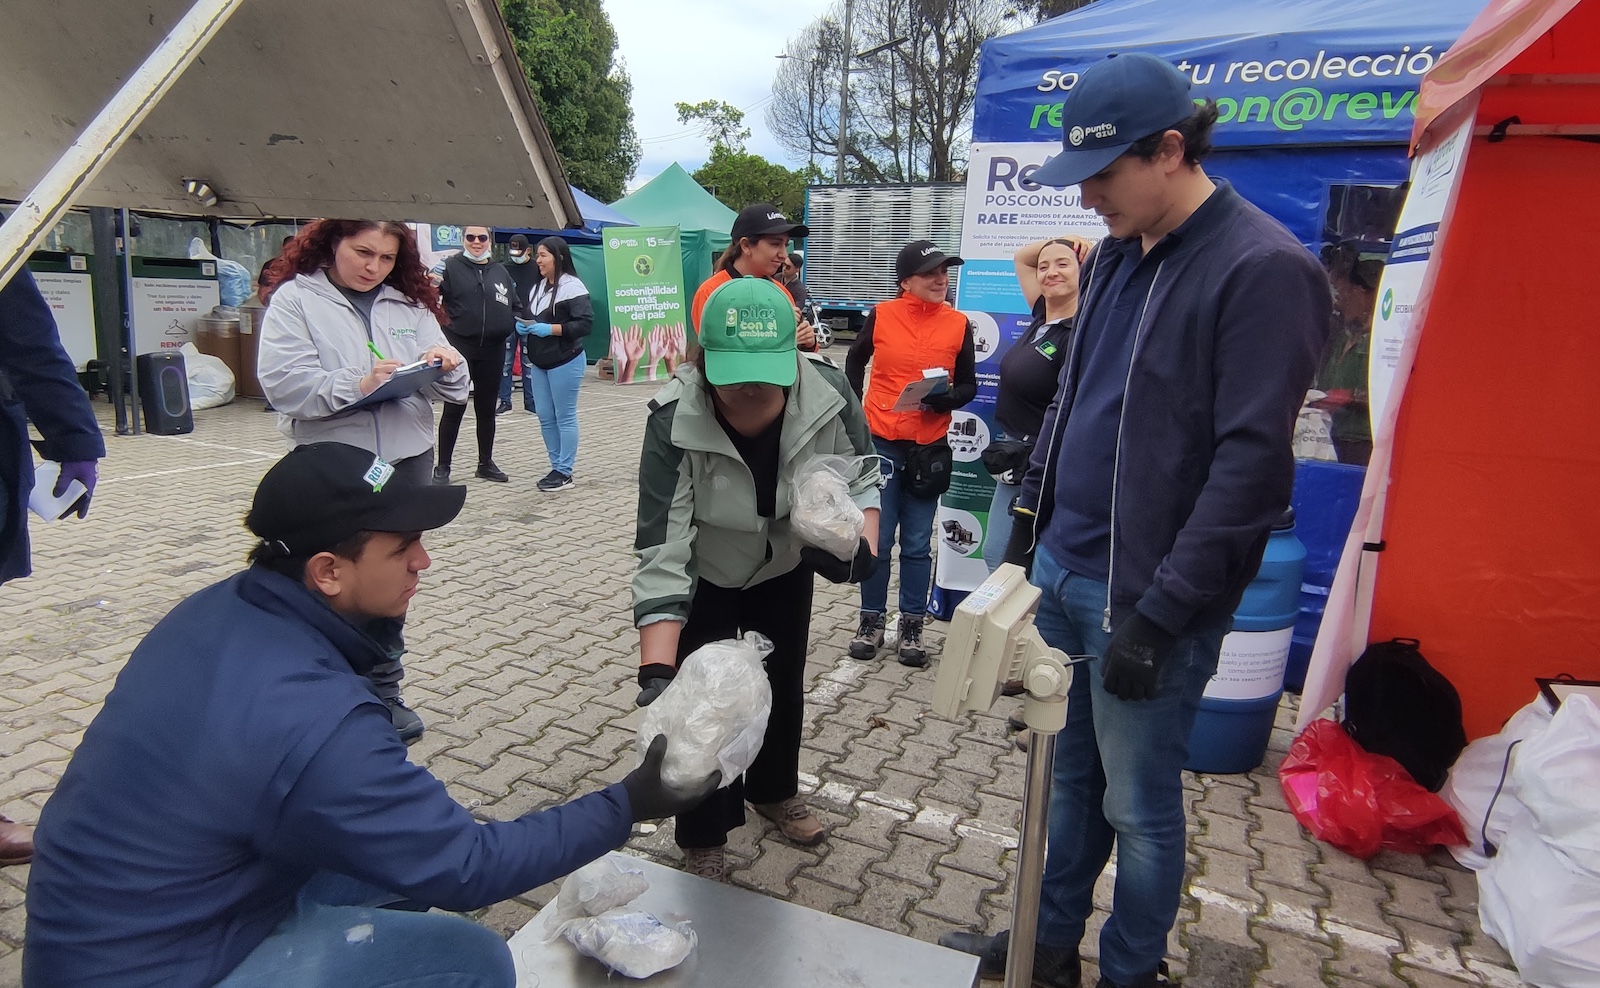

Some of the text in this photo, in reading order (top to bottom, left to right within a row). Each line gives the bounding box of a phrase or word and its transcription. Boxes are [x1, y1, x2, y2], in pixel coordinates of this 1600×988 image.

[1224, 45, 1446, 83] recolecció
[1085, 123, 1112, 136] punto
[1095, 126, 1117, 139] azul
[977, 213, 1019, 225] RAEE
[646, 237, 658, 248] 15
[614, 285, 678, 297] sostenibilidad
[637, 294, 657, 304] más
[614, 301, 680, 313] representativo
[630, 309, 666, 321] del país
[740, 305, 776, 322] pilas
[740, 319, 778, 331] con el
[367, 466, 383, 484] RED
